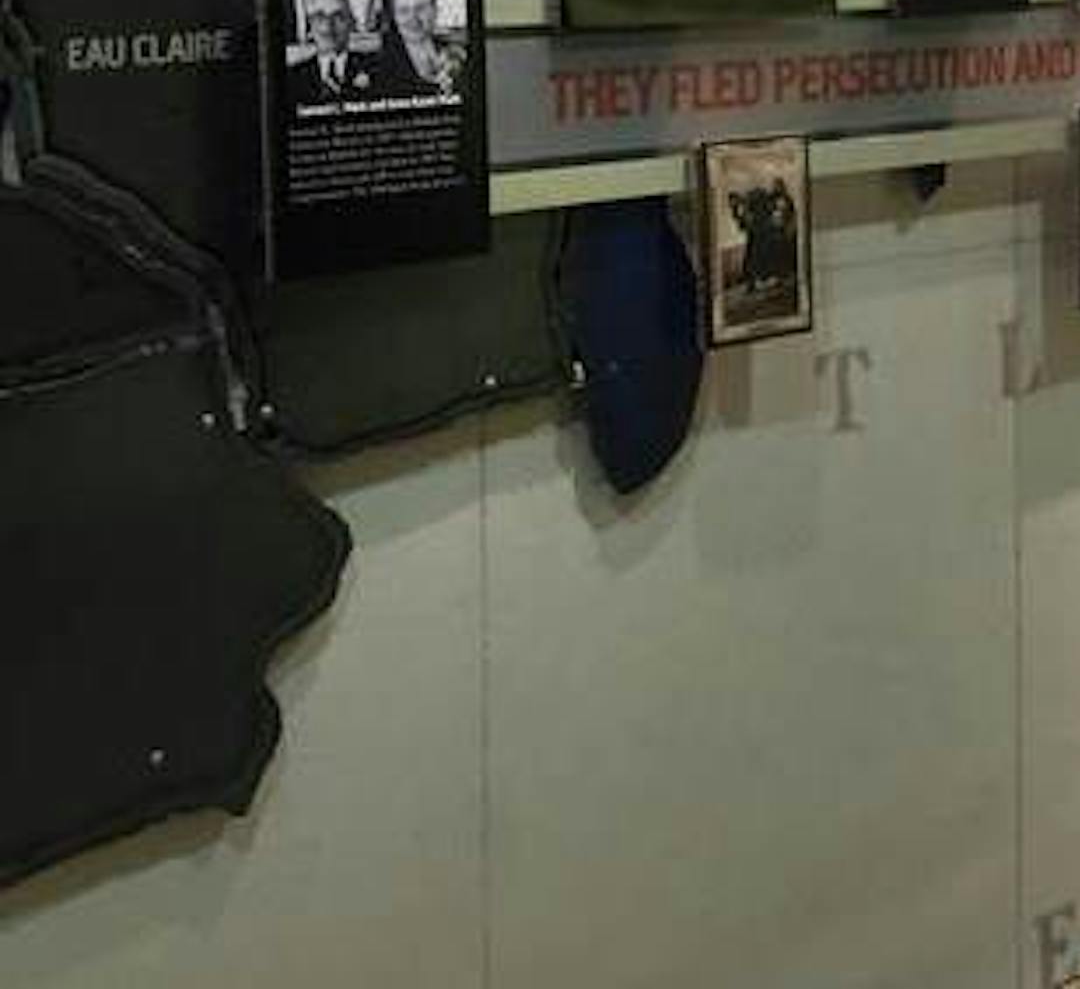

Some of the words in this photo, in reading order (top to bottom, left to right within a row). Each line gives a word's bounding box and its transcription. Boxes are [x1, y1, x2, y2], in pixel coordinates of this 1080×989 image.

[67, 35, 127, 71] EAU
[132, 29, 233, 62] CLAIRE
[550, 57, 658, 126] THEY
[670, 59, 760, 112] FLED
[773, 42, 1005, 103] PERSECUTION
[1012, 39, 1076, 84] AND
